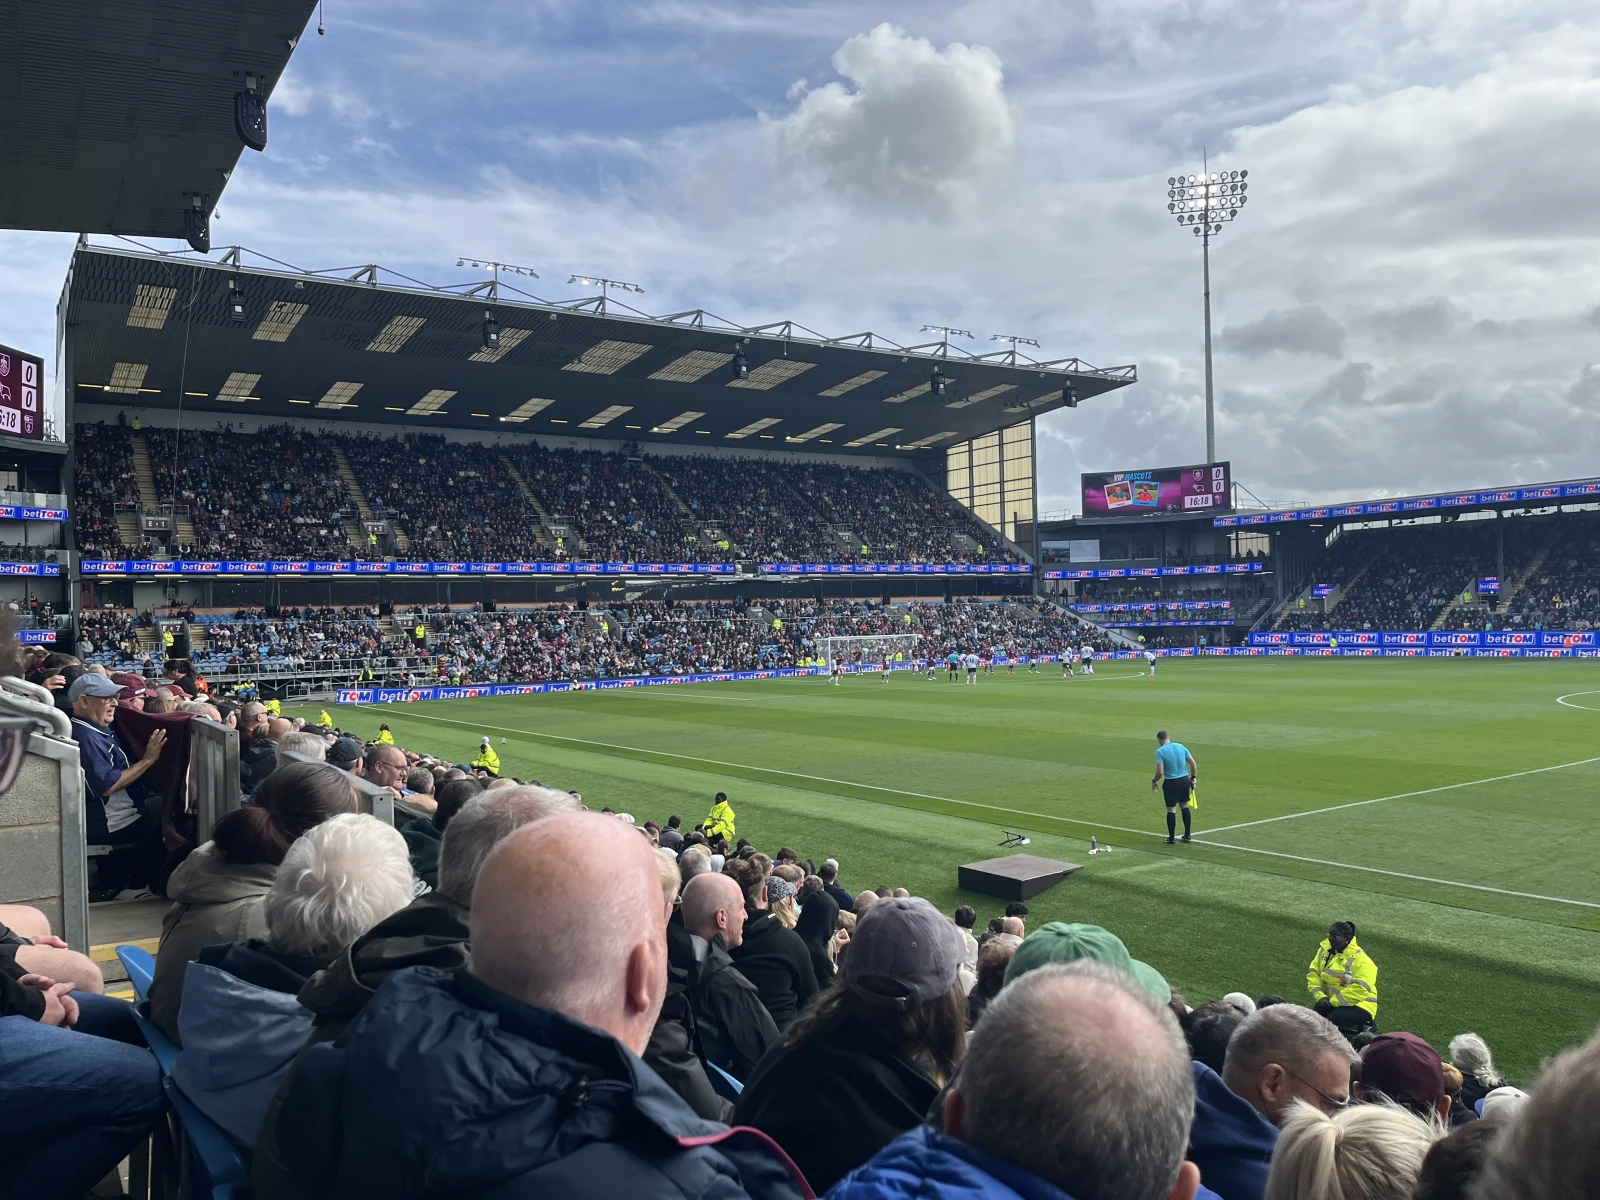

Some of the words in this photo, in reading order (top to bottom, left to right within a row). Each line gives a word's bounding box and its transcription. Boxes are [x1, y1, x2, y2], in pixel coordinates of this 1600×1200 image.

[26, 365, 33, 382] 0
[26, 390, 33, 408] 0
[216, 421, 244, 429] THE
[1124, 472, 1152, 480] MASCOTS
[1215, 468, 1220, 479] 0
[1215, 482, 1221, 491] 0
[1190, 497, 1209, 506] 16:18
[1334, 507, 1362, 515] betTOM
[1367, 503, 1398, 512] betTOM
[1404, 500, 1436, 509] betTOM
[1442, 496, 1476, 505] betTOM
[1482, 492, 1516, 501] betTOM
[1523, 488, 1559, 498] betTOM
[23, 509, 63, 519] betTOM
[0, 566, 38, 574] betTOM
[84, 562, 125, 571] betTOM
[133, 562, 174, 571] betTOM
[182, 562, 220, 571] betTOM
[228, 563, 265, 571] betTOM
[272, 563, 308, 571] betTOM
[316, 563, 349, 571] betTOM
[26, 633, 56, 642] betTO
[1254, 634, 1289, 643] betTOM
[1295, 634, 1330, 643] betTOM
[1339, 635, 1377, 643] betTOM
[1384, 635, 1426, 643] betTOM
[1434, 635, 1478, 643] betTOM
[1487, 634, 1533, 643] betTOM
[1544, 634, 1593, 643] betOM
[337, 691, 373, 702] TOM
[440, 689, 489, 699] betTOM
